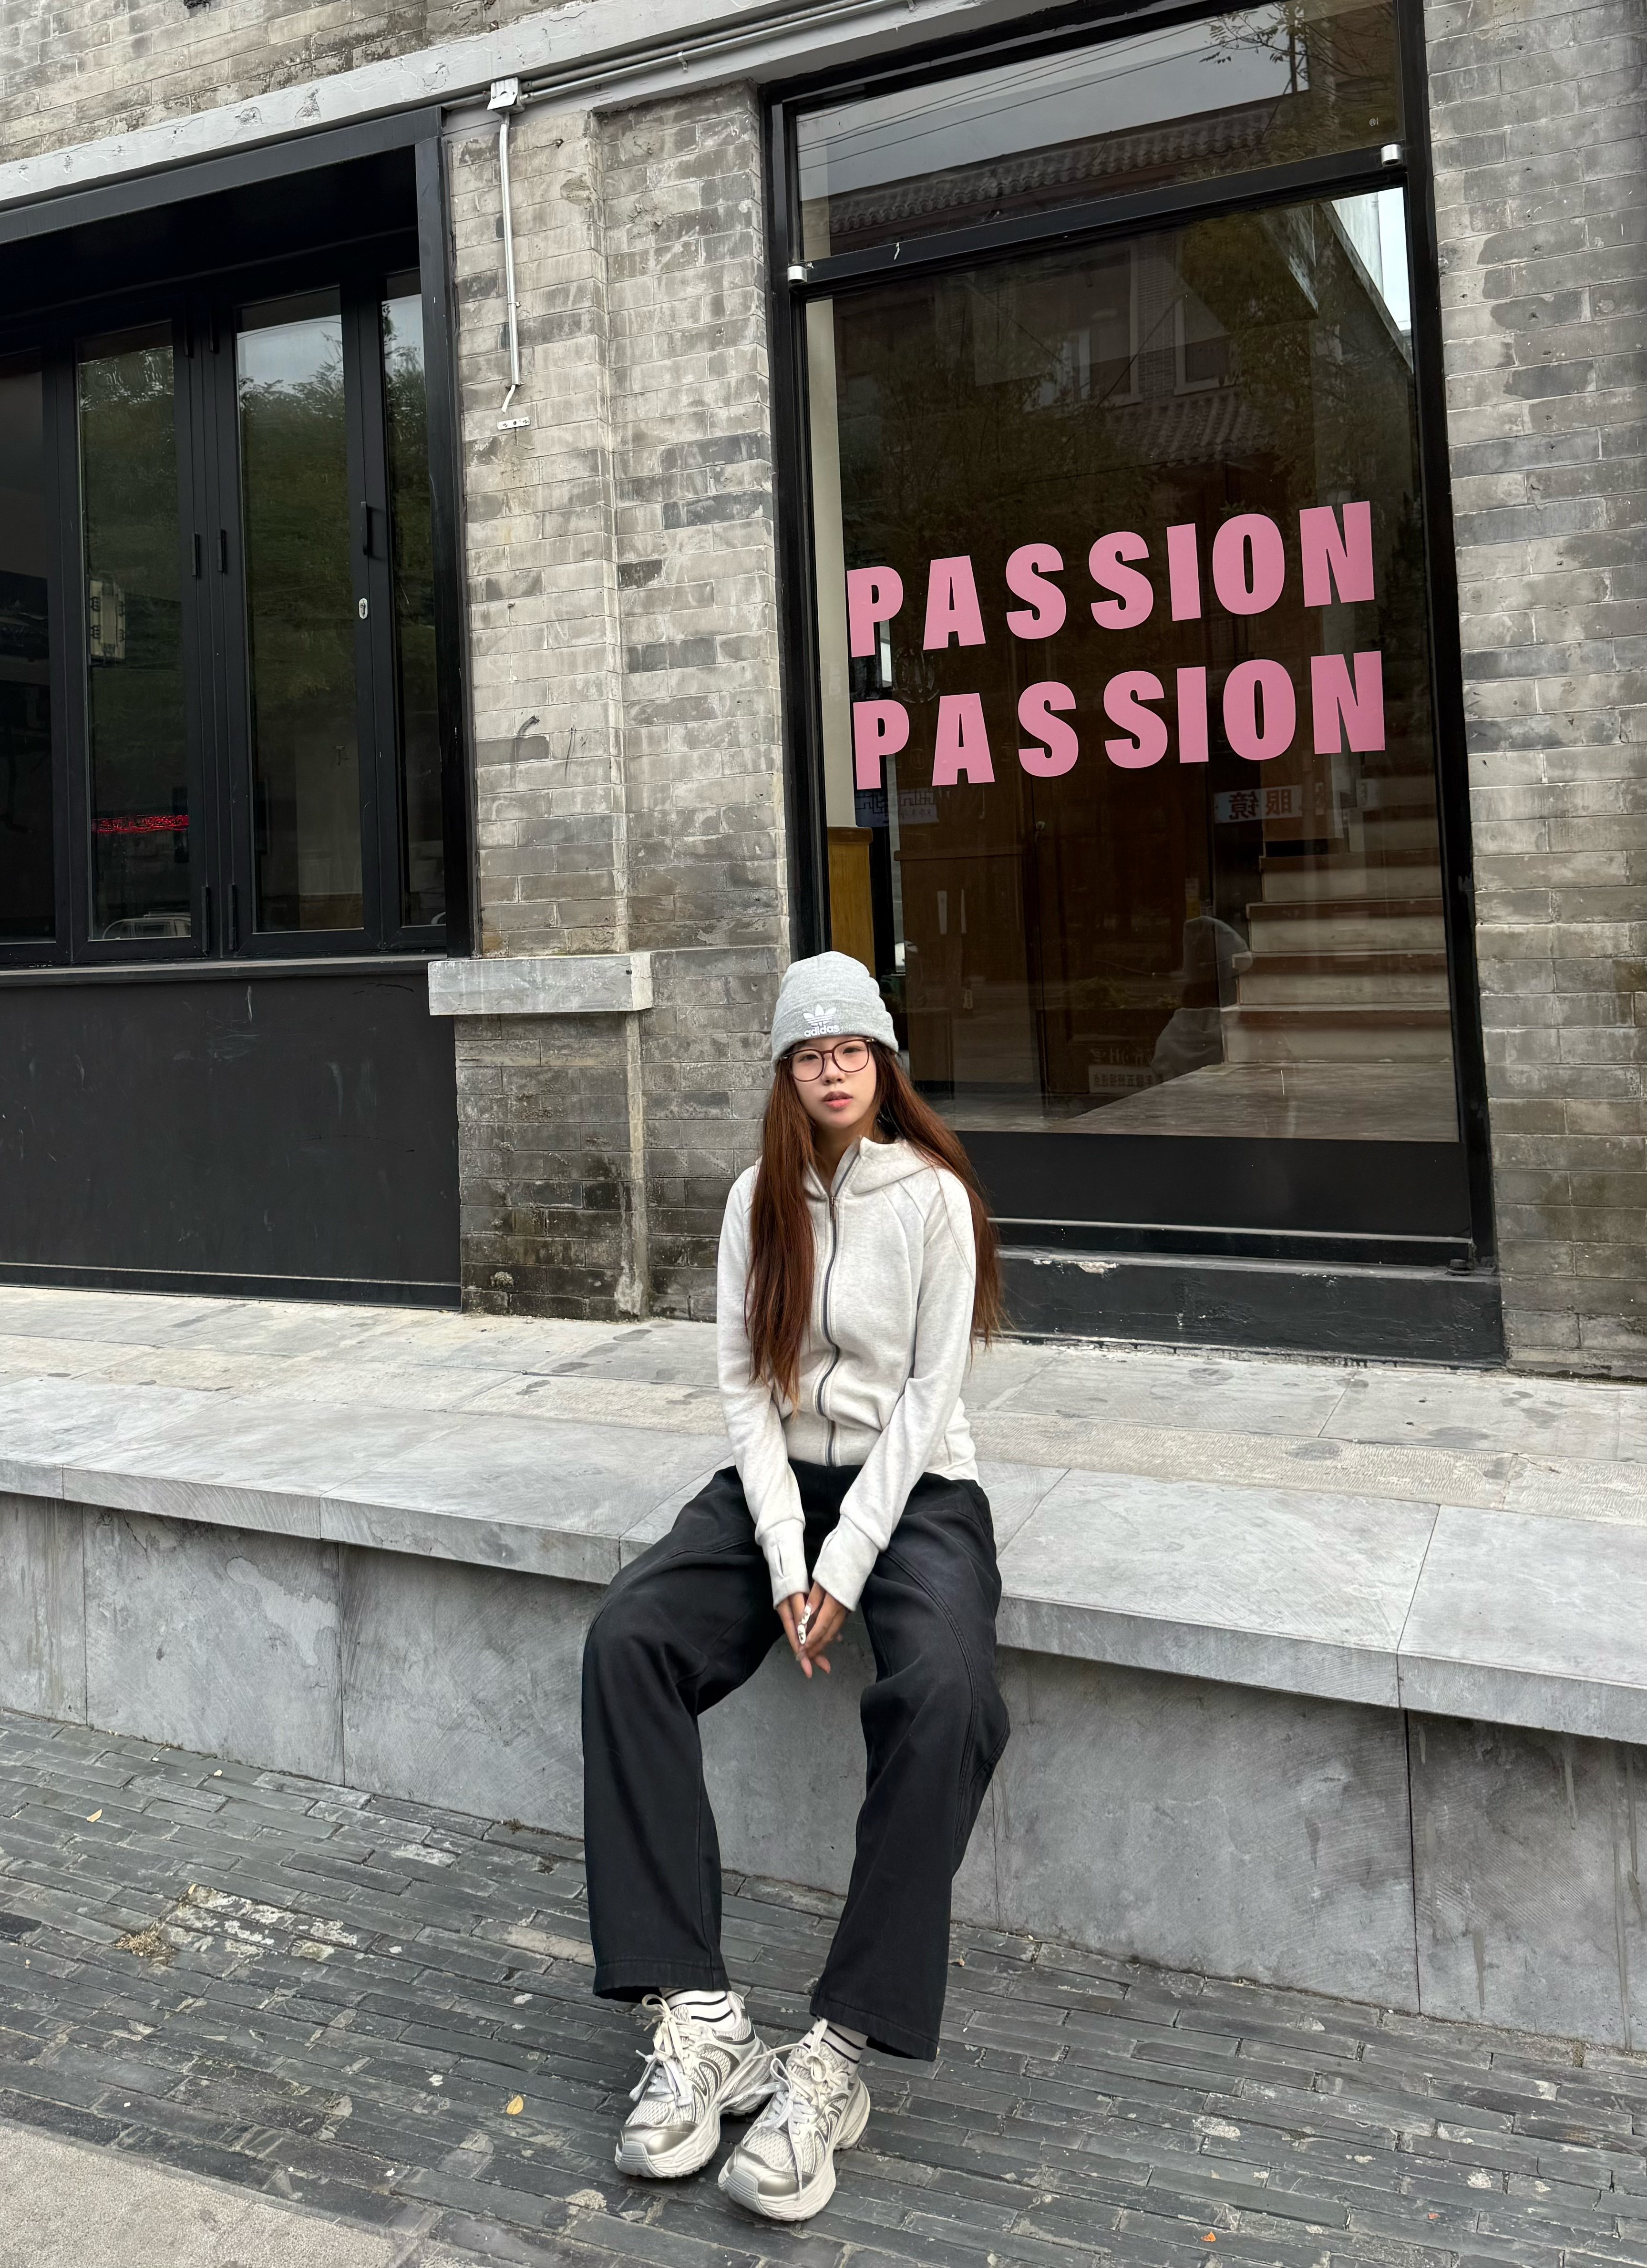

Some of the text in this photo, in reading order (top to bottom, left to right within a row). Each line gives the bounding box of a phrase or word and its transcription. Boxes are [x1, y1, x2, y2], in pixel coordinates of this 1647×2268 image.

[847, 501, 1375, 658] PASSION
[853, 651, 1386, 790] PASSION
[804, 1025, 840, 1037] adidas
